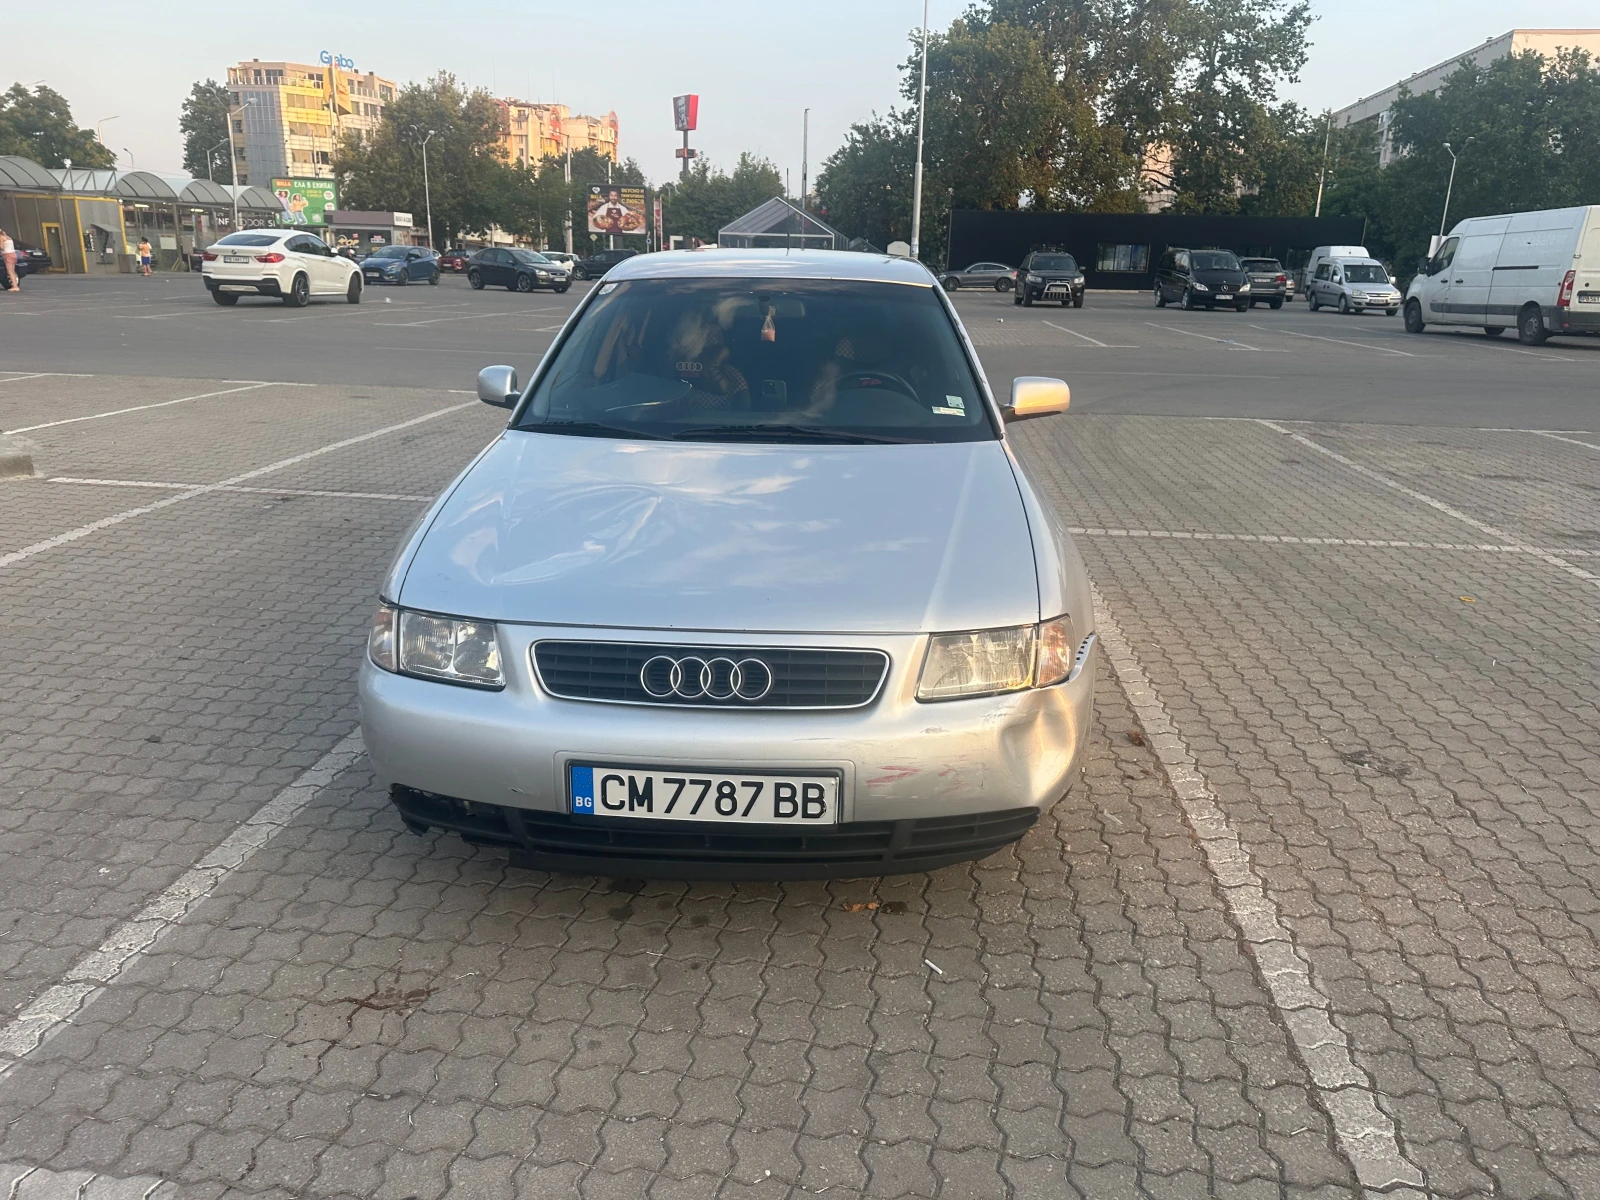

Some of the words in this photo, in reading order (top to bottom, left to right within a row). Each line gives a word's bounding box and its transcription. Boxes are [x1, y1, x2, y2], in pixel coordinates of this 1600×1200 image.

[320, 50, 354, 69] Grabo
[575, 796, 592, 808] BG
[600, 774, 653, 812] CM
[663, 778, 763, 817] 7787
[774, 782, 827, 819] BB
